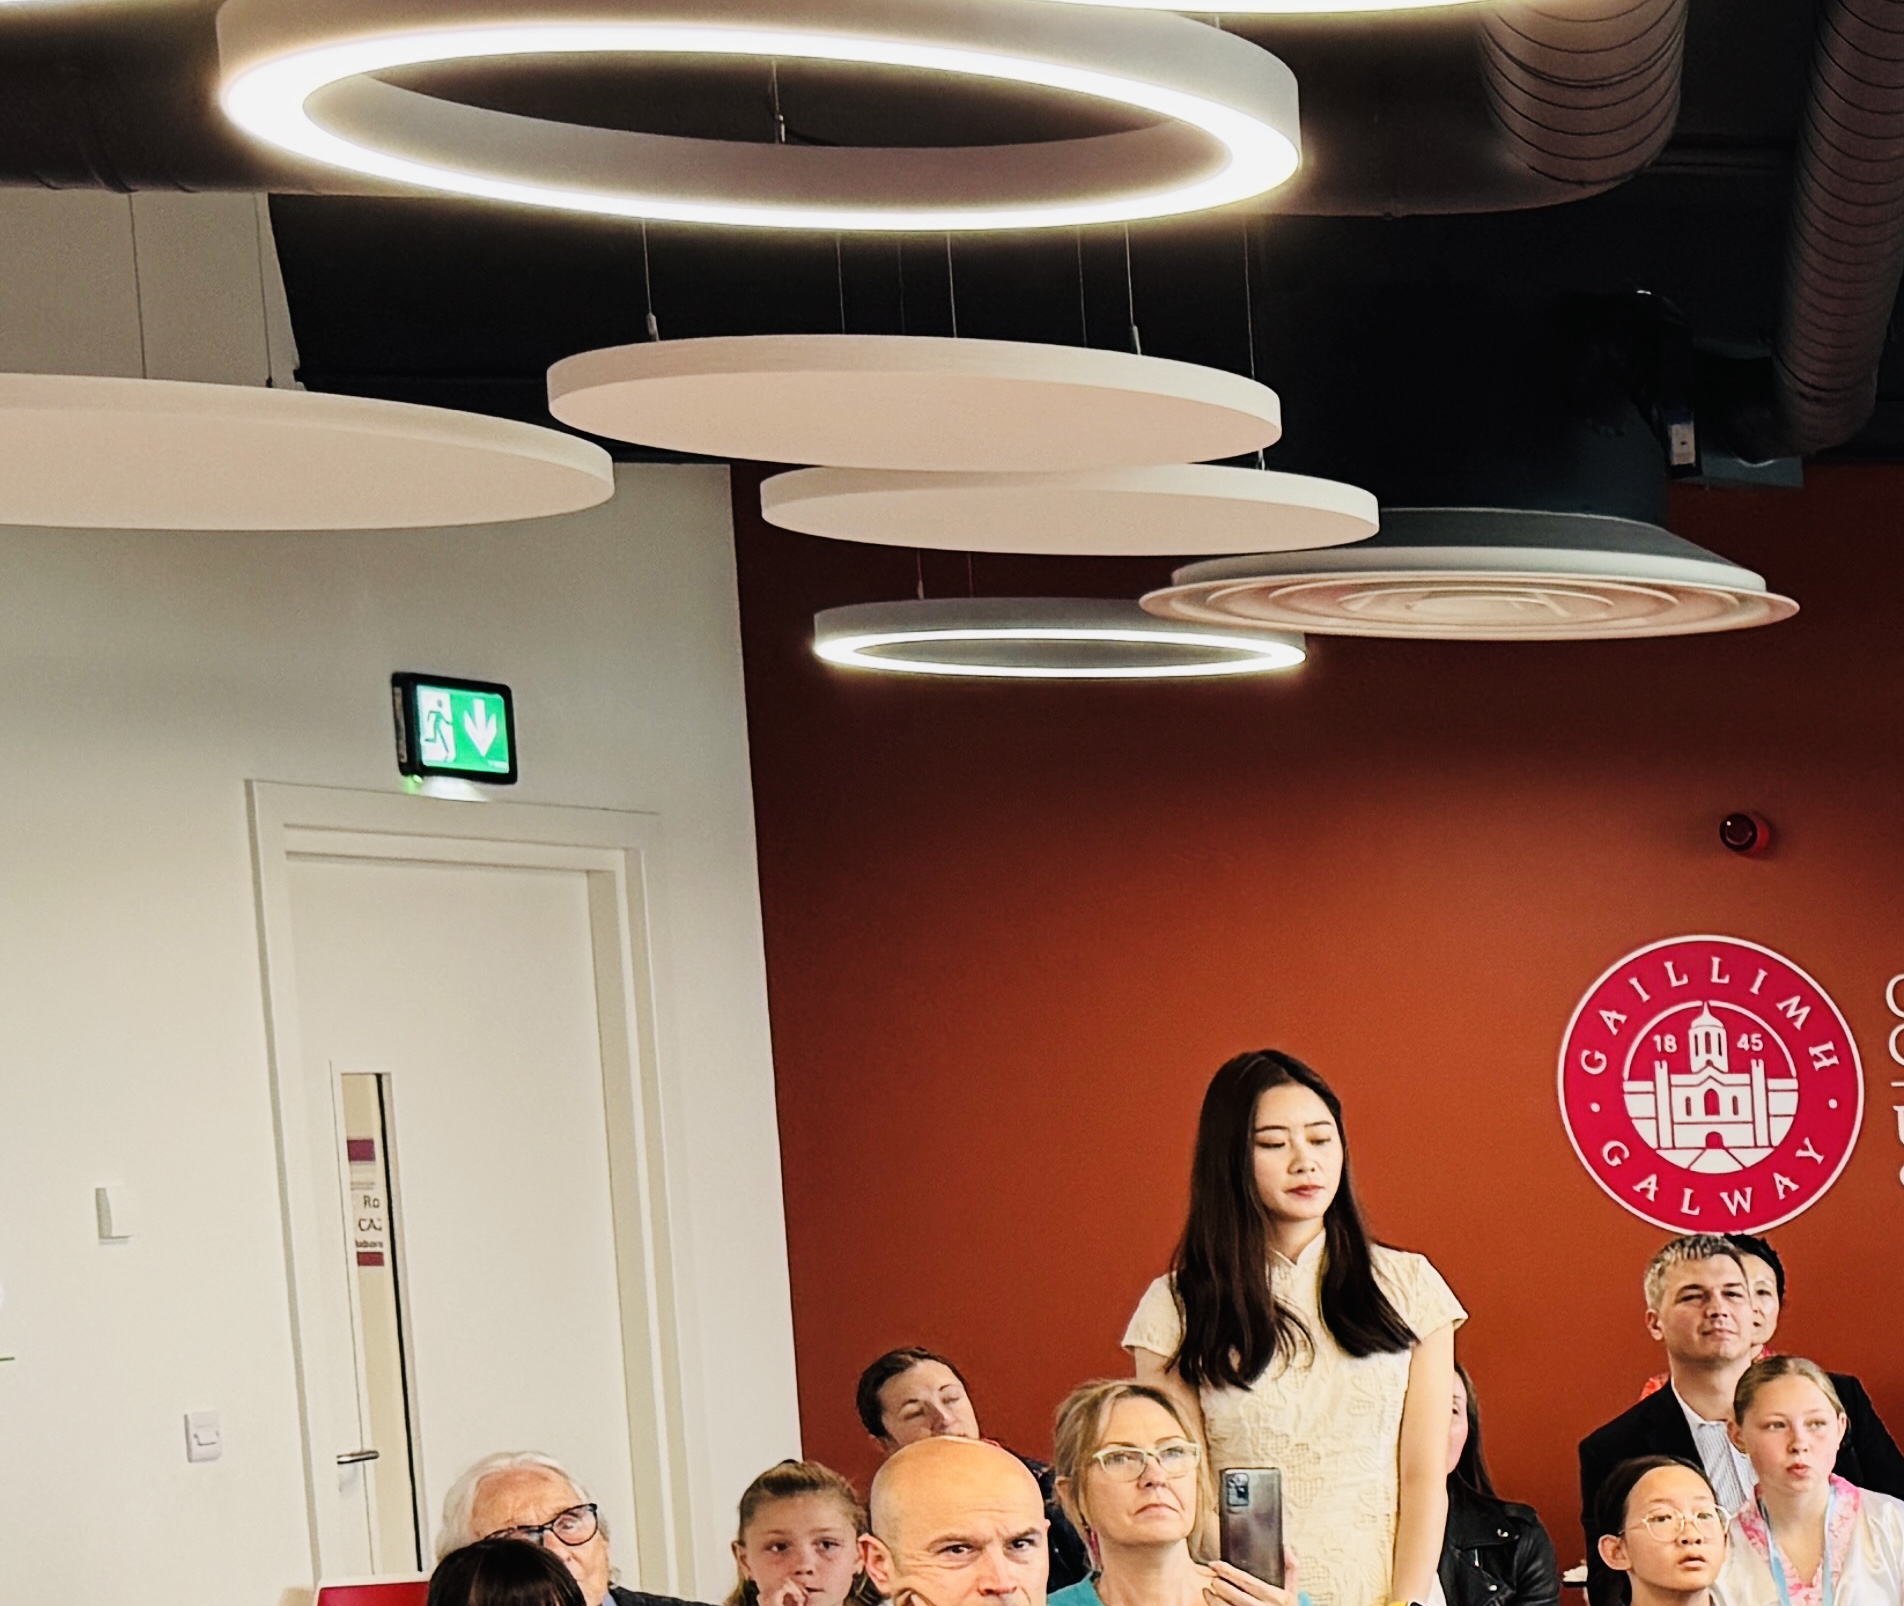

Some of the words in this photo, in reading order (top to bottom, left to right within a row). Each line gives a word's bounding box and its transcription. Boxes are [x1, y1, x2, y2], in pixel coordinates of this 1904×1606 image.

[1580, 955, 1840, 1075] GAILLIMH
[1653, 1033, 1678, 1053] 18
[1736, 1033, 1764, 1052] 45
[1602, 1137, 1825, 1217] GALWAY
